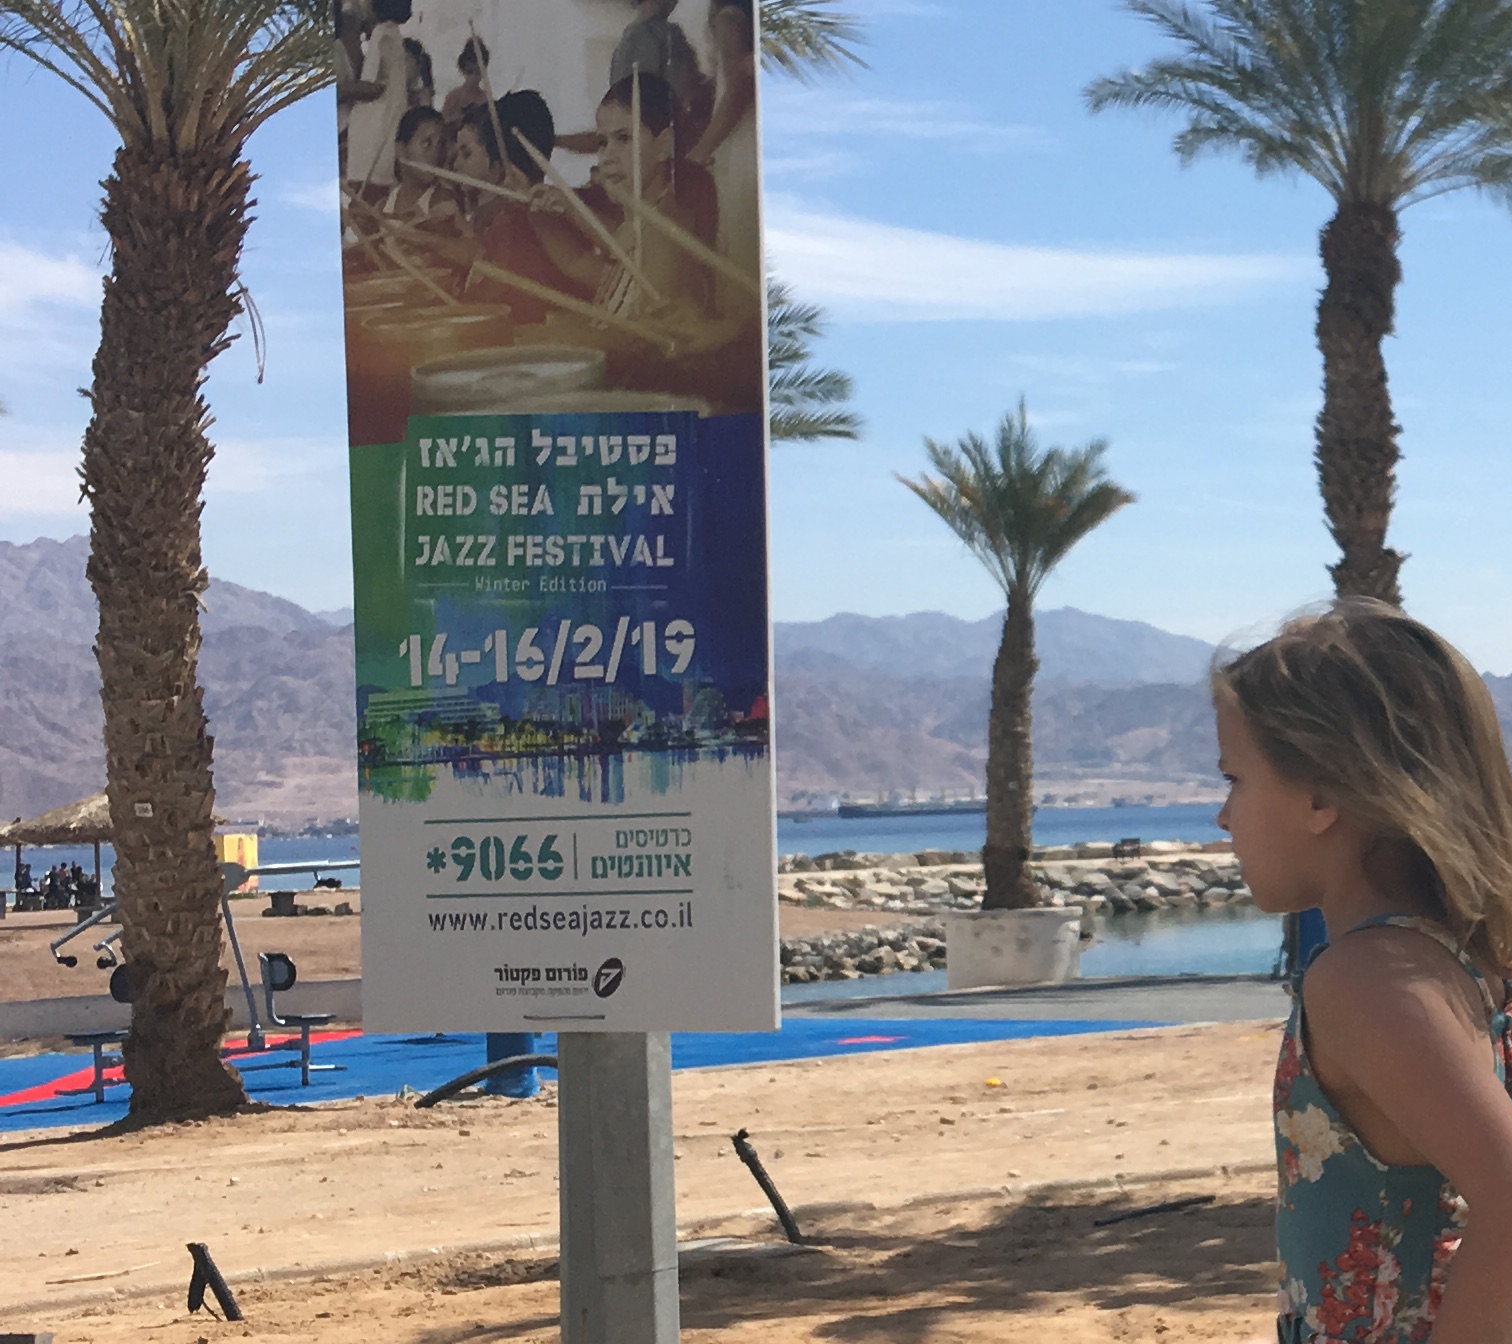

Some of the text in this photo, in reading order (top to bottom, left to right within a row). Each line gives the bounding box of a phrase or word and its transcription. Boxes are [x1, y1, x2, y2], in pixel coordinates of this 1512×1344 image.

[531, 428, 678, 468] פסטיבל
[415, 484, 554, 517] RED SEA
[576, 476, 676, 517] אילת
[415, 534, 675, 568] JAZZ FESTIVAL
[475, 575, 607, 592] Winter Edition
[400, 616, 697, 688] 14-16/2/19
[615, 827, 693, 850] כרטיסים
[590, 852, 693, 880] איוונטים
[428, 901, 694, 937] www.redseajazz.co.il
